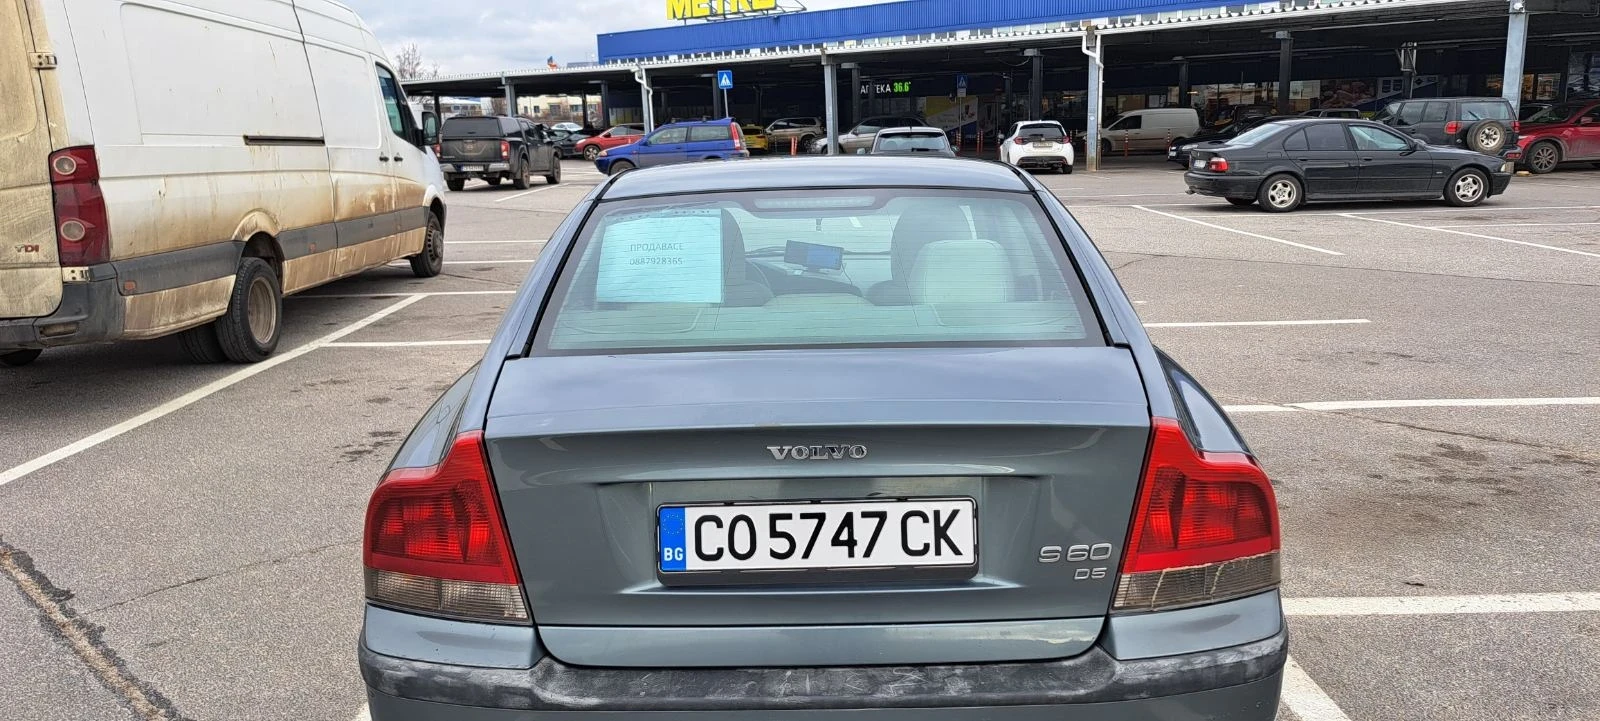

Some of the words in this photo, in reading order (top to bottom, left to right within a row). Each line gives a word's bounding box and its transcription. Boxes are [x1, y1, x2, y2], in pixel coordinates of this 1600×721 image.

[860, 83, 892, 94] АПЕКА
[14, 244, 39, 253] TDI
[630, 243, 684, 252] ПРОДАВАСЕ
[767, 444, 867, 460] VOLVO
[769, 511, 888, 560] 5747
[900, 509, 963, 557] CK
[663, 547, 683, 561] BG
[1073, 567, 1108, 581] D5
